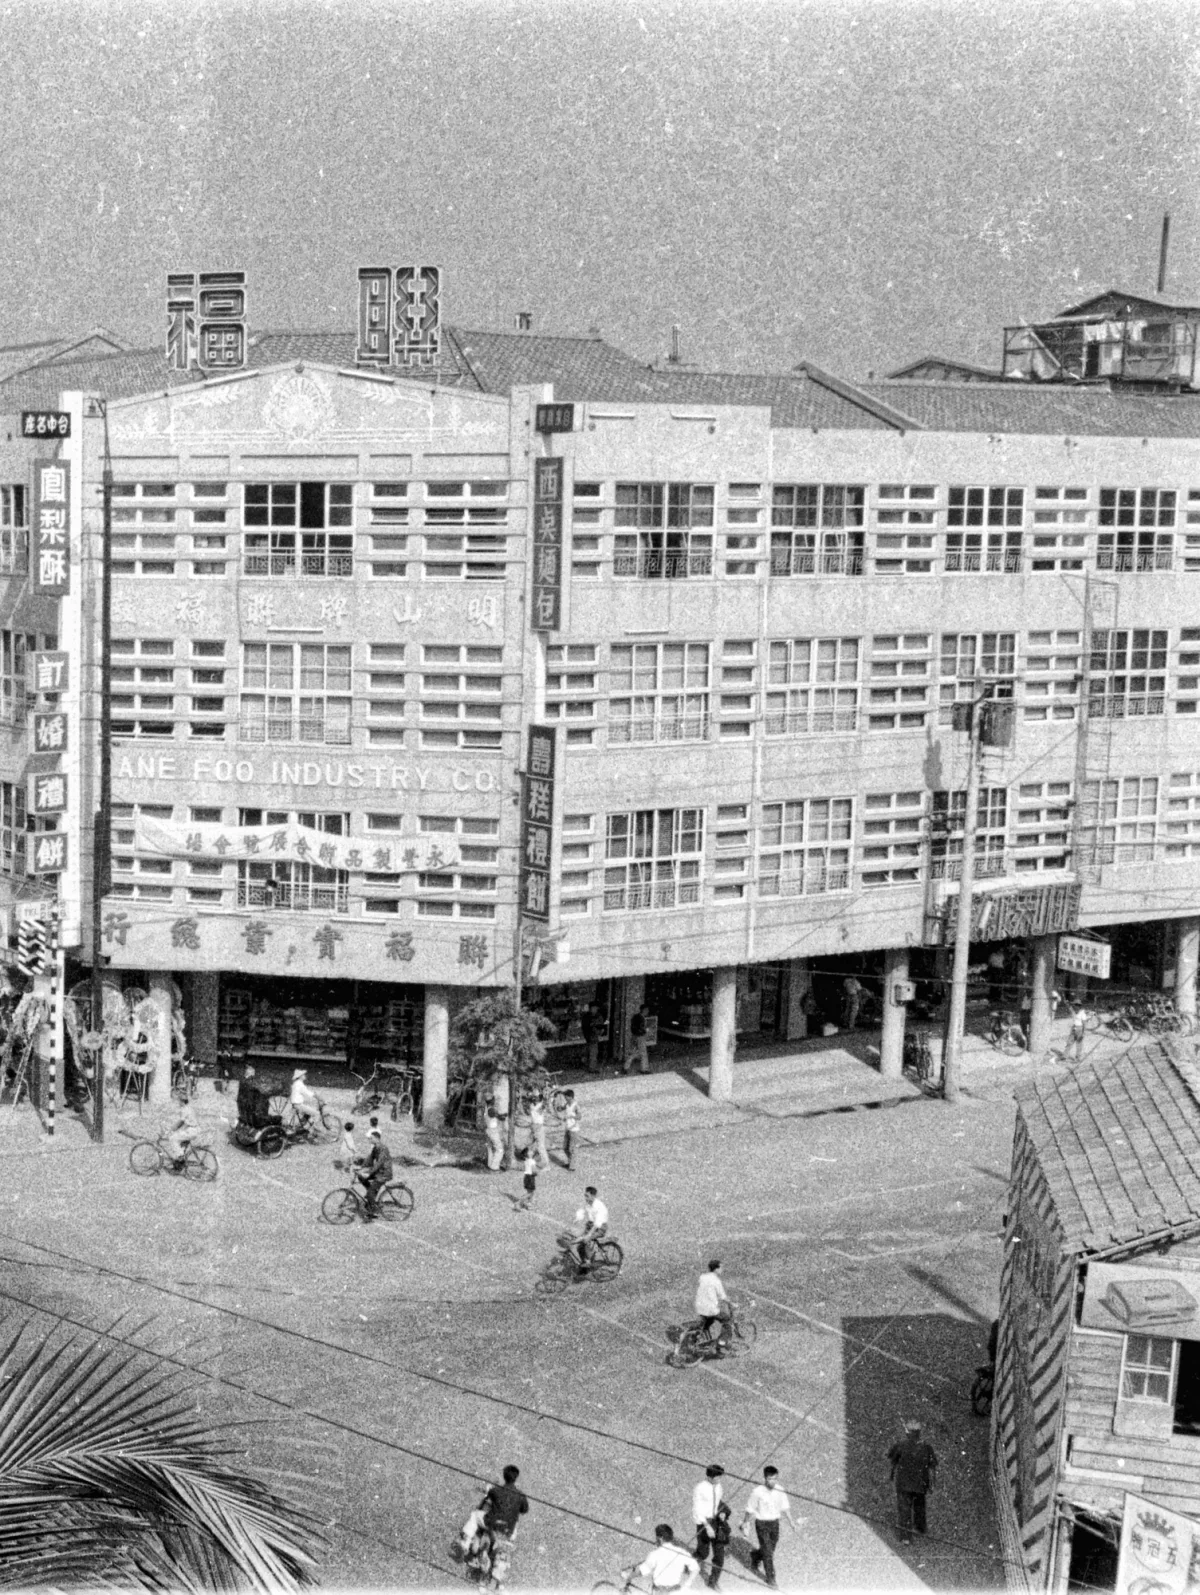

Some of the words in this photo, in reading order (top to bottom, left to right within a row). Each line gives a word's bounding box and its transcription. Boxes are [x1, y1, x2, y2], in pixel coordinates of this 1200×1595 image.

[24, 414, 69, 434] 台中名產
[39, 465, 67, 586] 鳳梨酥
[37, 655, 65, 869] 訂婚禮餅
[193, 757, 254, 783] FOO
[272, 761, 432, 791] INDUSTRY
